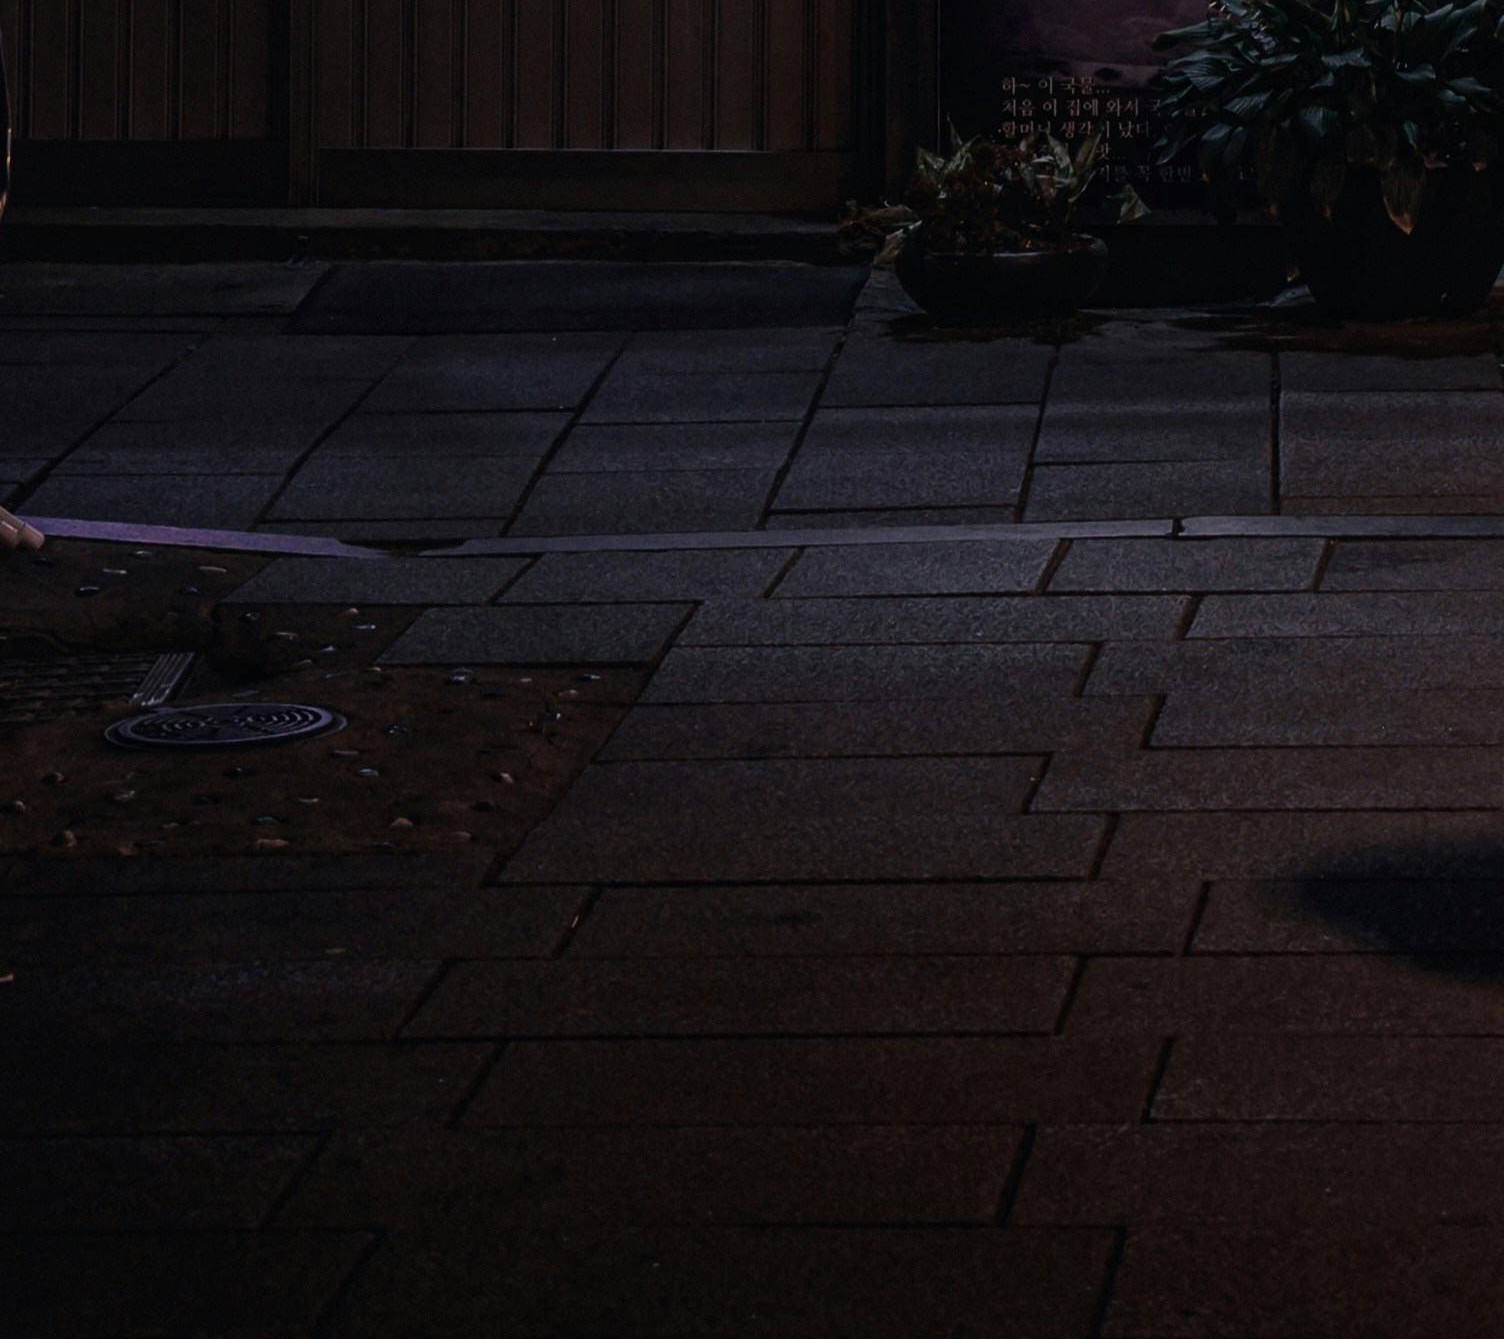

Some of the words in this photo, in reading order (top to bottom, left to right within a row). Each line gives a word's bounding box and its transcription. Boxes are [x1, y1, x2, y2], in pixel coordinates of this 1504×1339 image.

[1042, 98, 1058, 118] 이
[1066, 98, 1099, 118] 집에
[1106, 98, 1140, 118] 와서
